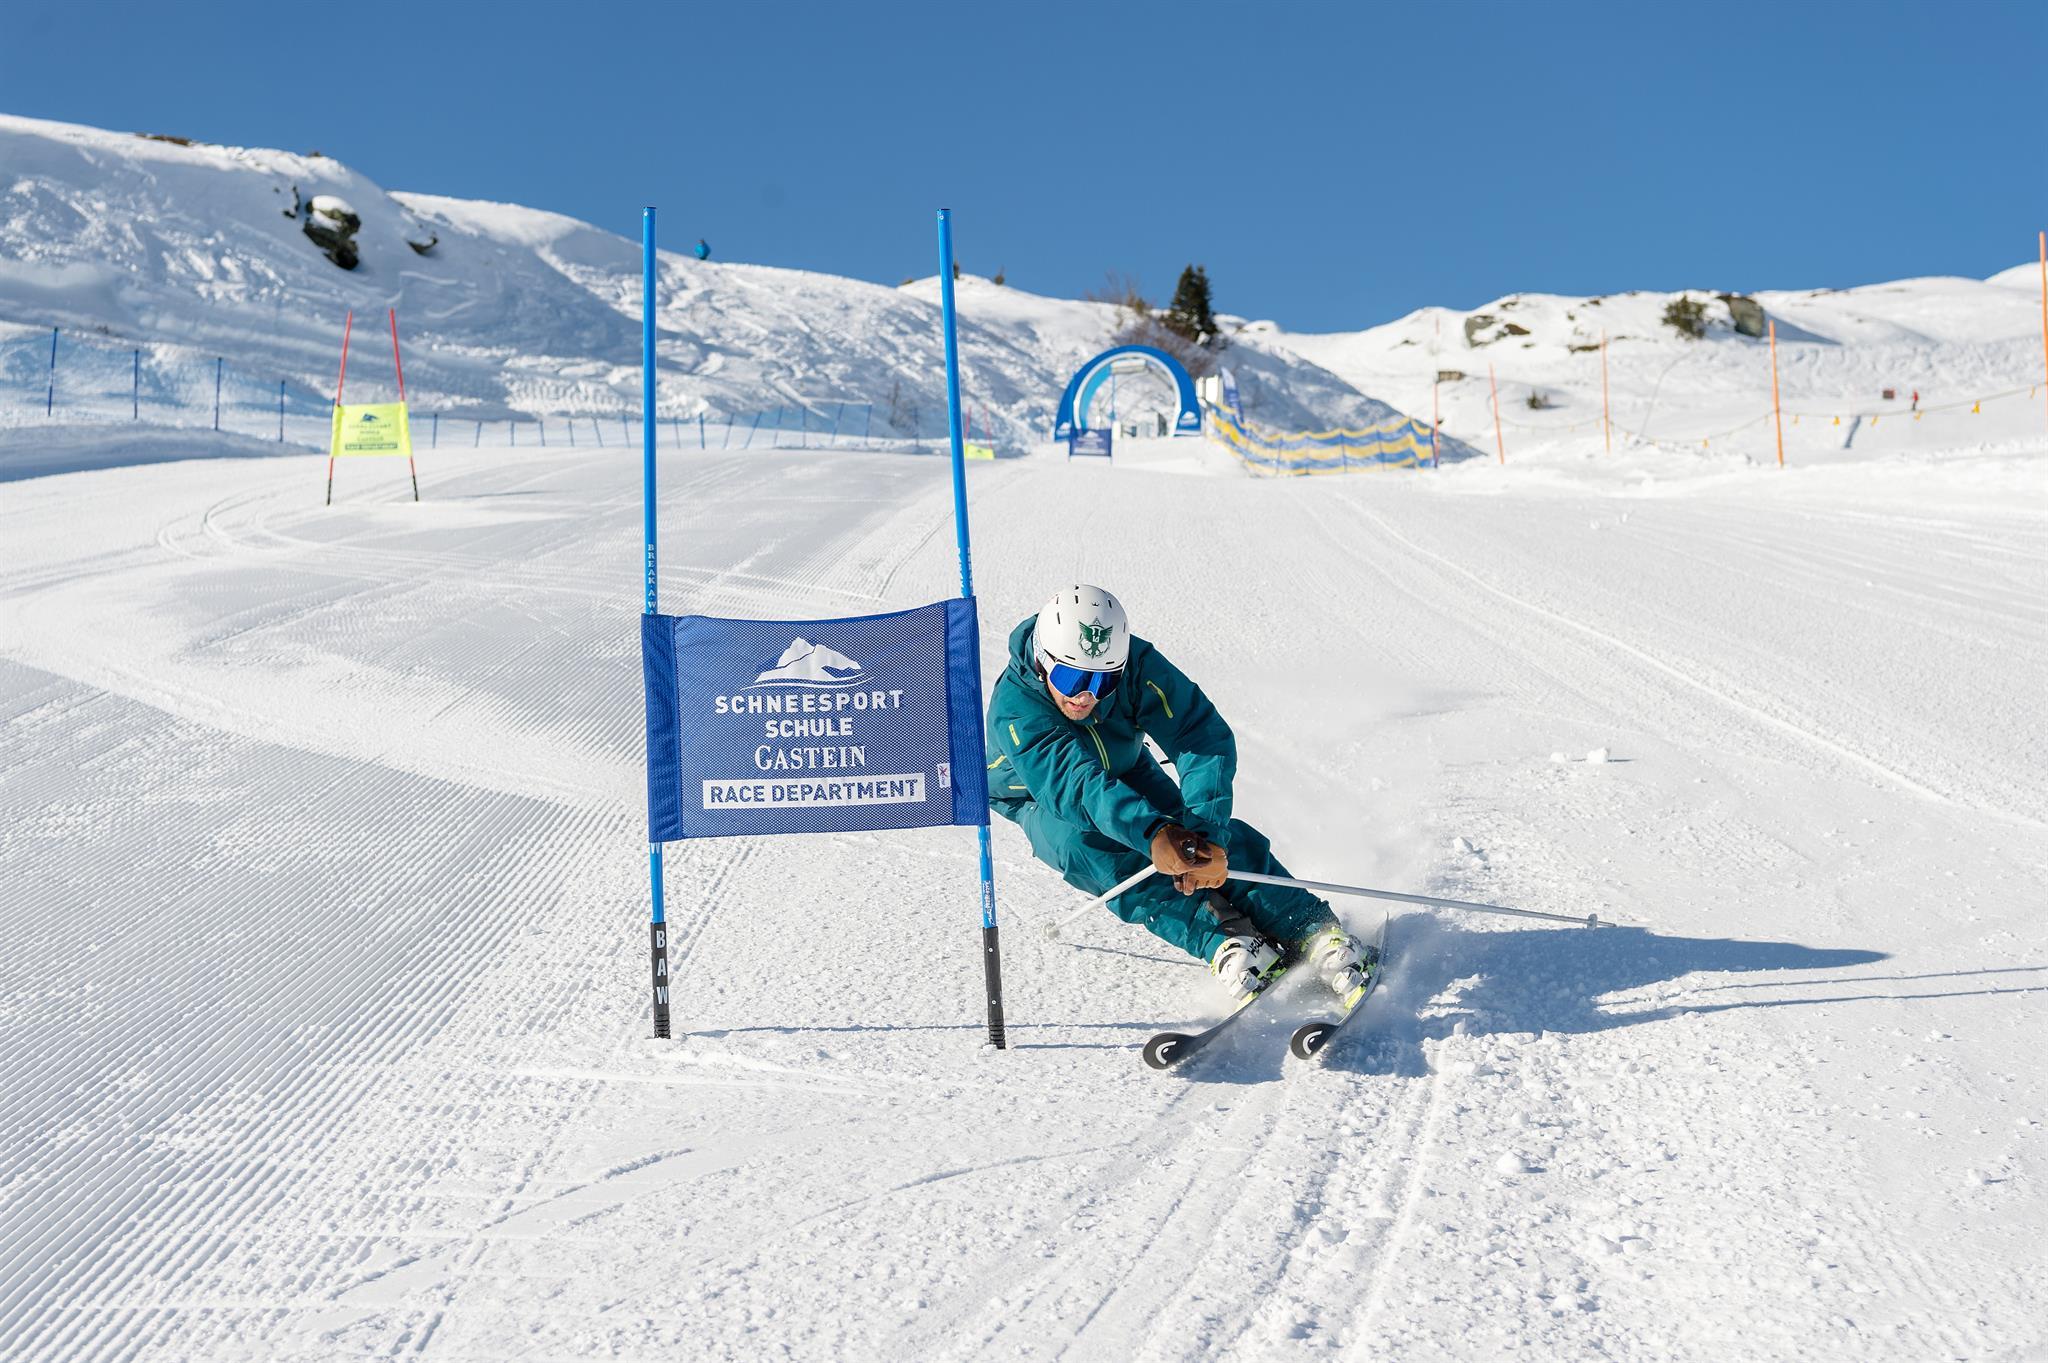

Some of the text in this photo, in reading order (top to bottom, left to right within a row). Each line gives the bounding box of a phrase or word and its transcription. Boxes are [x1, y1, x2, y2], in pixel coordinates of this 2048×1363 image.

[714, 689, 904, 714] SCHNEESPORT
[765, 717, 854, 738] SCHULE
[754, 744, 866, 771] GASTEIN
[710, 784, 766, 804] RACE
[771, 778, 919, 803] DEPARTMENT
